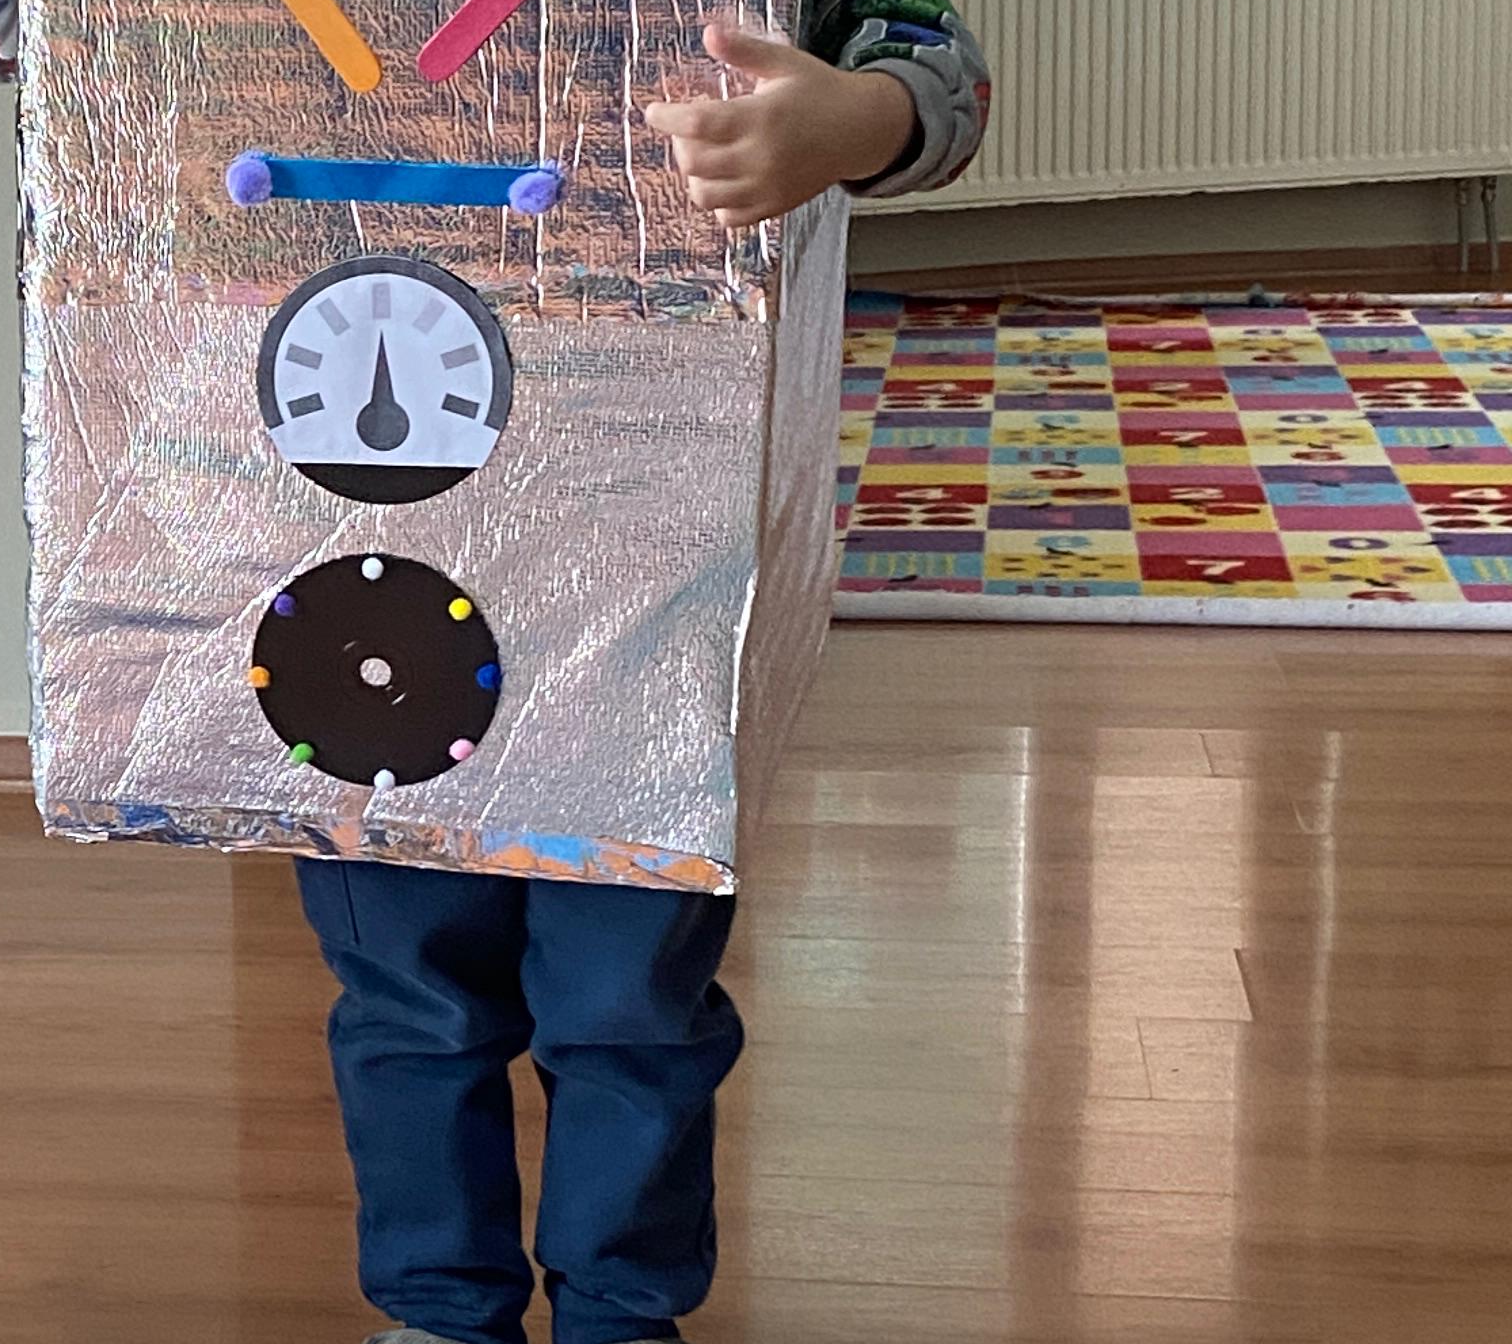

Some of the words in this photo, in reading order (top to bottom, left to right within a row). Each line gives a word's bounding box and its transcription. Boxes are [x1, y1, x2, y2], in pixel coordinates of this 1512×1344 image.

[1159, 431, 1209, 443] 7
[895, 487, 952, 500] 4
[1449, 487, 1509, 500] 4
[1186, 559, 1246, 576] 7
